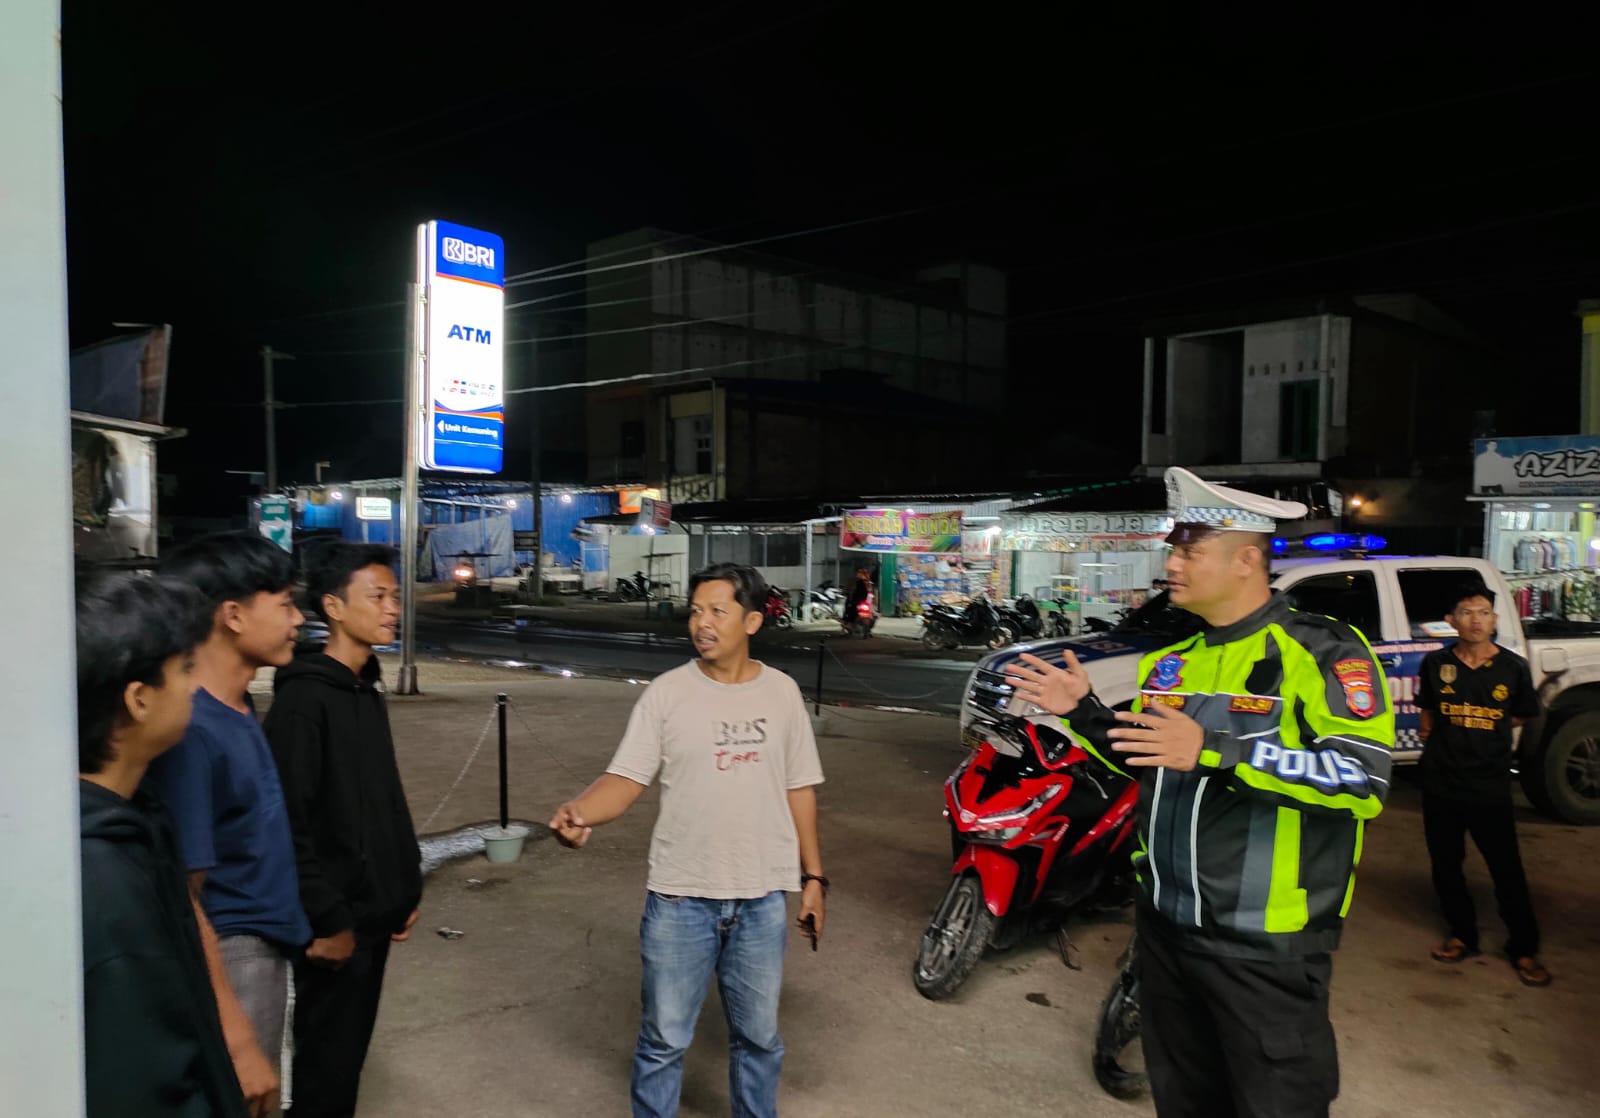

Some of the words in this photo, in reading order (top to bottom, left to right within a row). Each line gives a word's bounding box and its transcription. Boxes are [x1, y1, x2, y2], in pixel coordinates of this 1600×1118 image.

[464, 242, 495, 270] BRI
[447, 324, 491, 345] ATM
[444, 423, 461, 433] Unit
[907, 517, 960, 535] BUNDA
